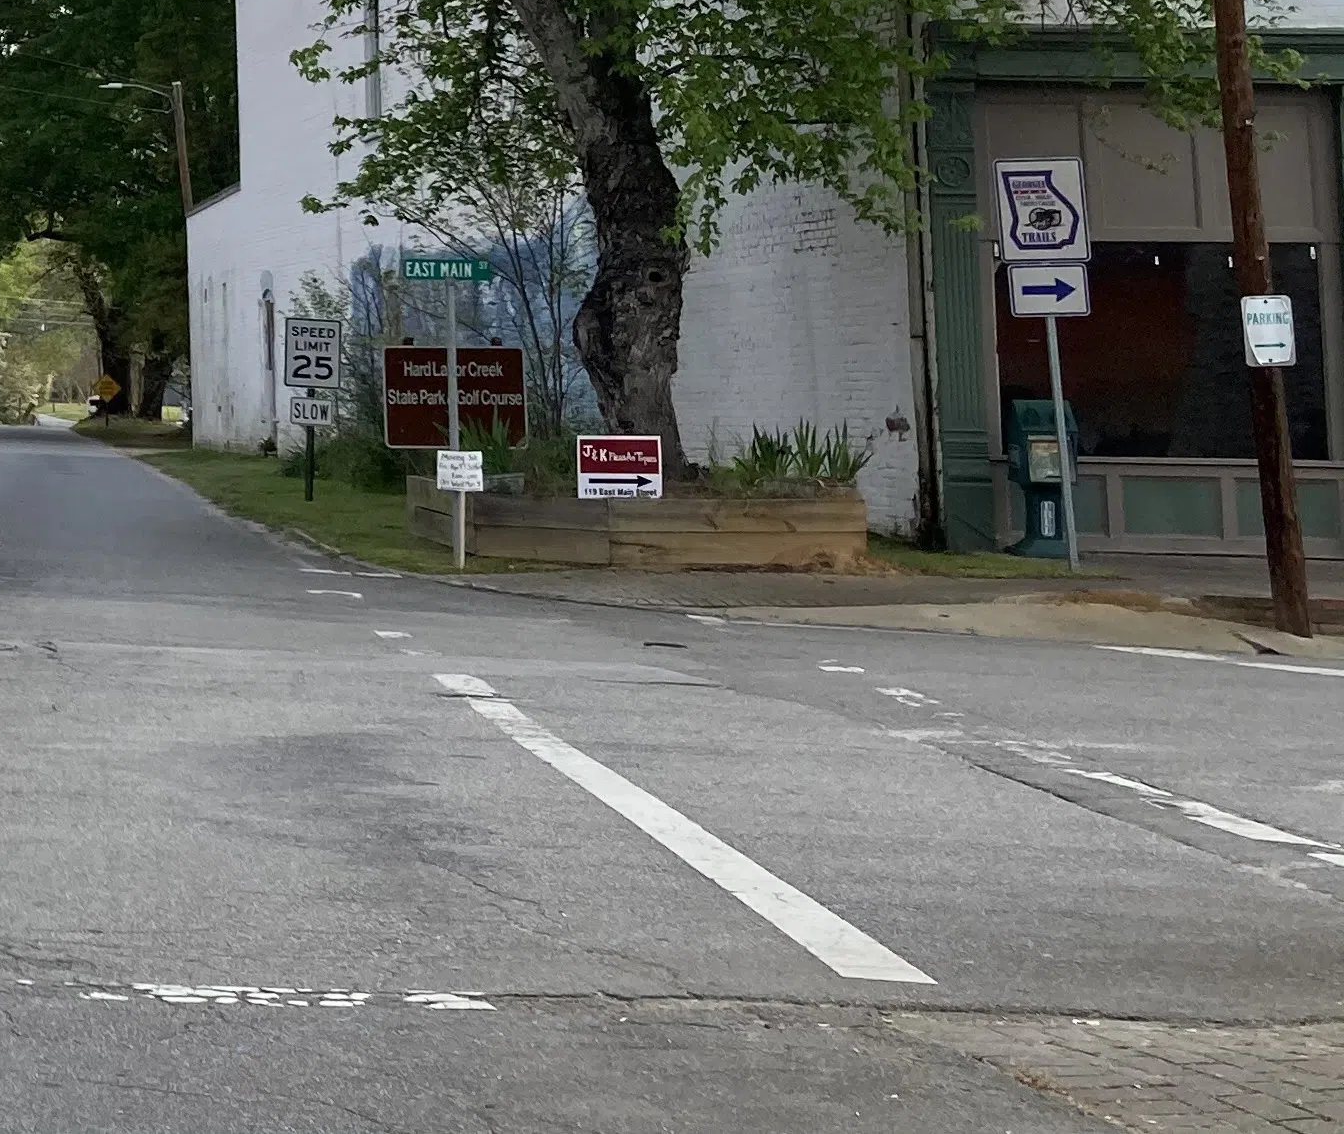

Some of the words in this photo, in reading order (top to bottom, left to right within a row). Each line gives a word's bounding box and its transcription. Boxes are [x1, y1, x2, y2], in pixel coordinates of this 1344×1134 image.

[1021, 231, 1057, 243] TRAILS
[406, 261, 435, 277] EAST
[440, 261, 472, 277] MAIN
[1246, 312, 1290, 326] PARKING
[292, 326, 336, 339] SPEED
[295, 340, 331, 352] LIMIT
[292, 355, 333, 380] 25
[403, 361, 431, 377] Hard
[432, 361, 466, 377] Laor
[467, 361, 504, 377] Creek
[388, 389, 418, 405] State
[419, 389, 446, 405] Park
[457, 389, 480, 405] Golf
[480, 389, 523, 406] Course
[293, 402, 329, 421] SLOW
[582, 445, 593, 457] J
[599, 448, 608, 462] K
[599, 488, 616, 496] East
[617, 488, 634, 496] Main
